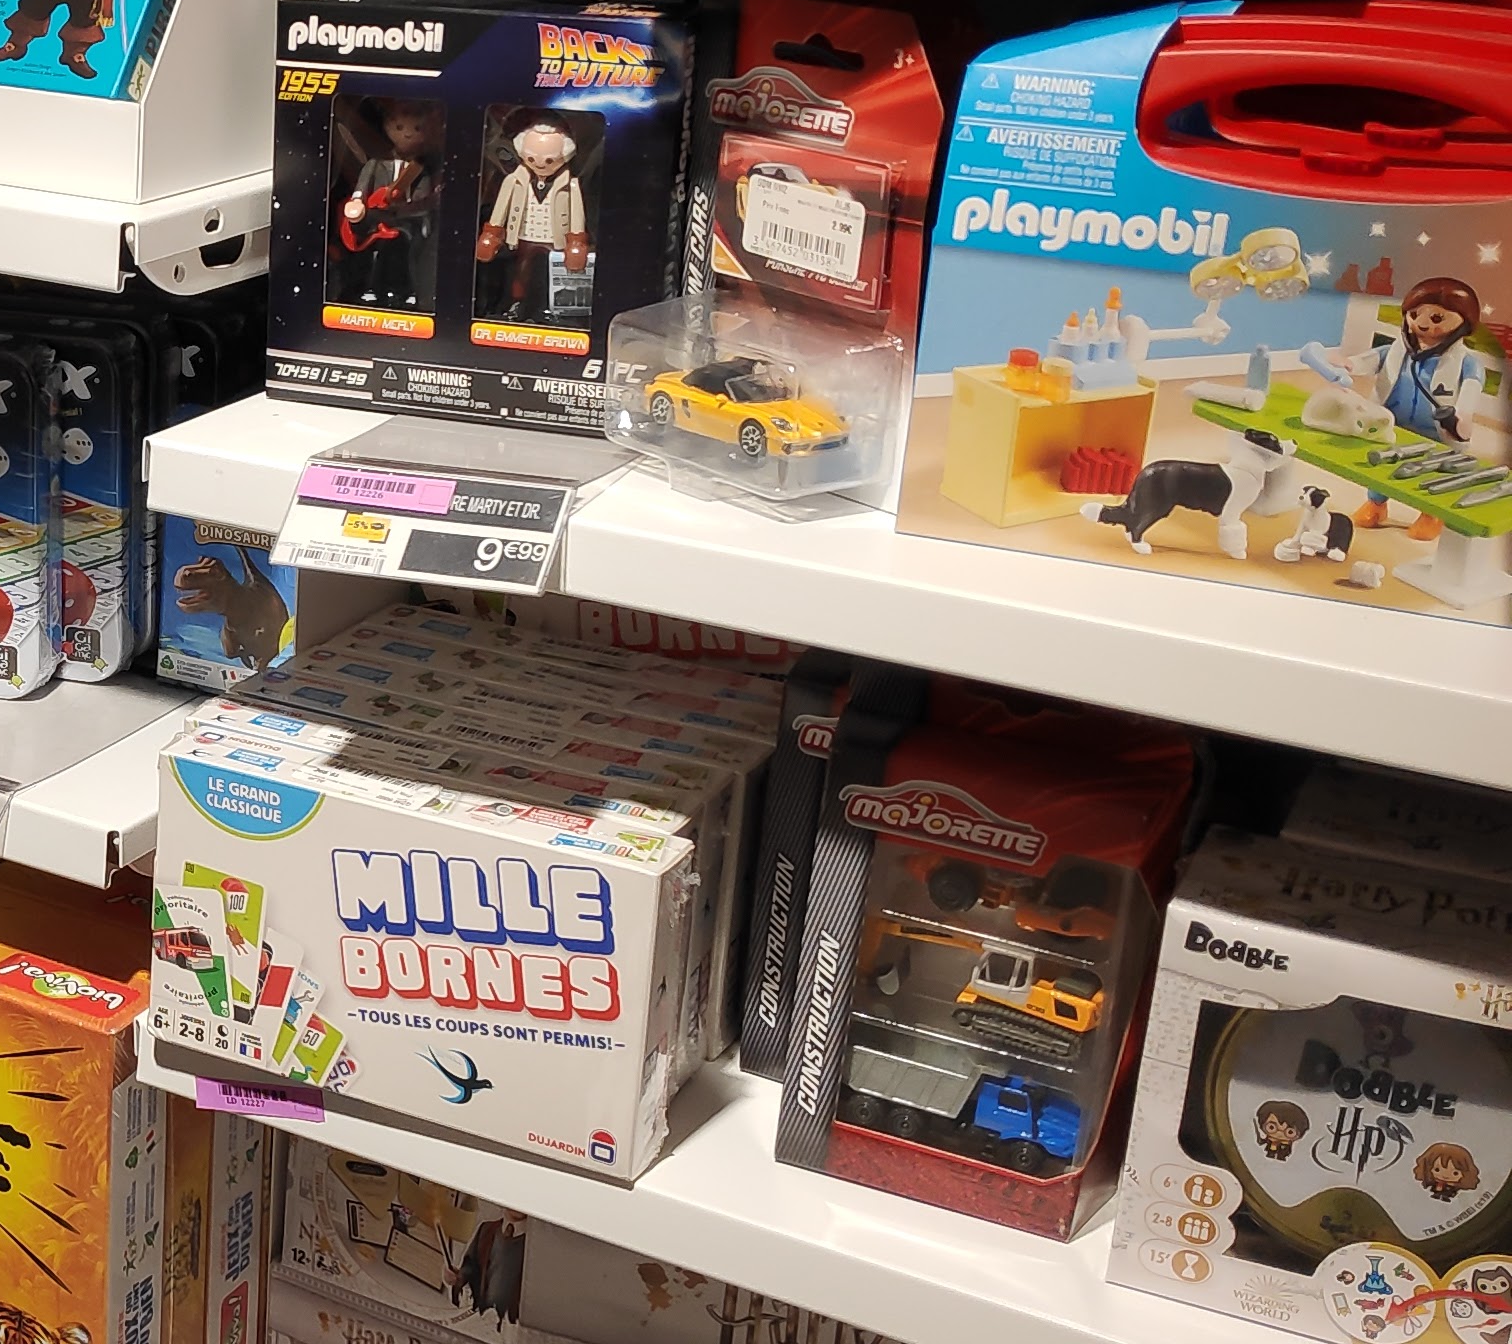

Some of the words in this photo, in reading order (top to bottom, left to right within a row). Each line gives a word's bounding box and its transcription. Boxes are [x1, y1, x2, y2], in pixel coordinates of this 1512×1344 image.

[289, 16, 445, 56] playmobil
[538, 23, 648, 65] BACK
[539, 58, 562, 74] TO
[559, 61, 666, 89] FUTURE
[279, 69, 340, 95] 1955
[1014, 74, 1096, 96] WARNING:
[278, 92, 314, 103] EDITION
[986, 127, 1121, 156] AVERTISSEMENT:
[951, 189, 1230, 256] playmobil
[339, 313, 378, 330] MARTY
[495, 330, 542, 348] EMMETT
[407, 368, 472, 389] WARNING:
[207, 775, 223, 793] LE
[224, 778, 282, 808] GRAND
[205, 791, 283, 825] CLASSIQUE
[331, 848, 616, 956] MILLE
[755, 852, 796, 1029] CONSTRUCTION
[339, 936, 621, 1022] BORNES
[153, 1014, 171, 1030] 6+
[178, 1022, 206, 1043] 2-8
[214, 1038, 229, 1050] 20
[403, 1013, 432, 1032] LES
[434, 1017, 490, 1038] COUPS
[492, 1023, 539, 1042] SONT
[795, 928, 847, 1118] CONSTRUCTION
[527, 1131, 587, 1158] DUJARDIN
[1232, 1288, 1301, 1317] WIZARDING
[1238, 1300, 1291, 1324] WORLD
